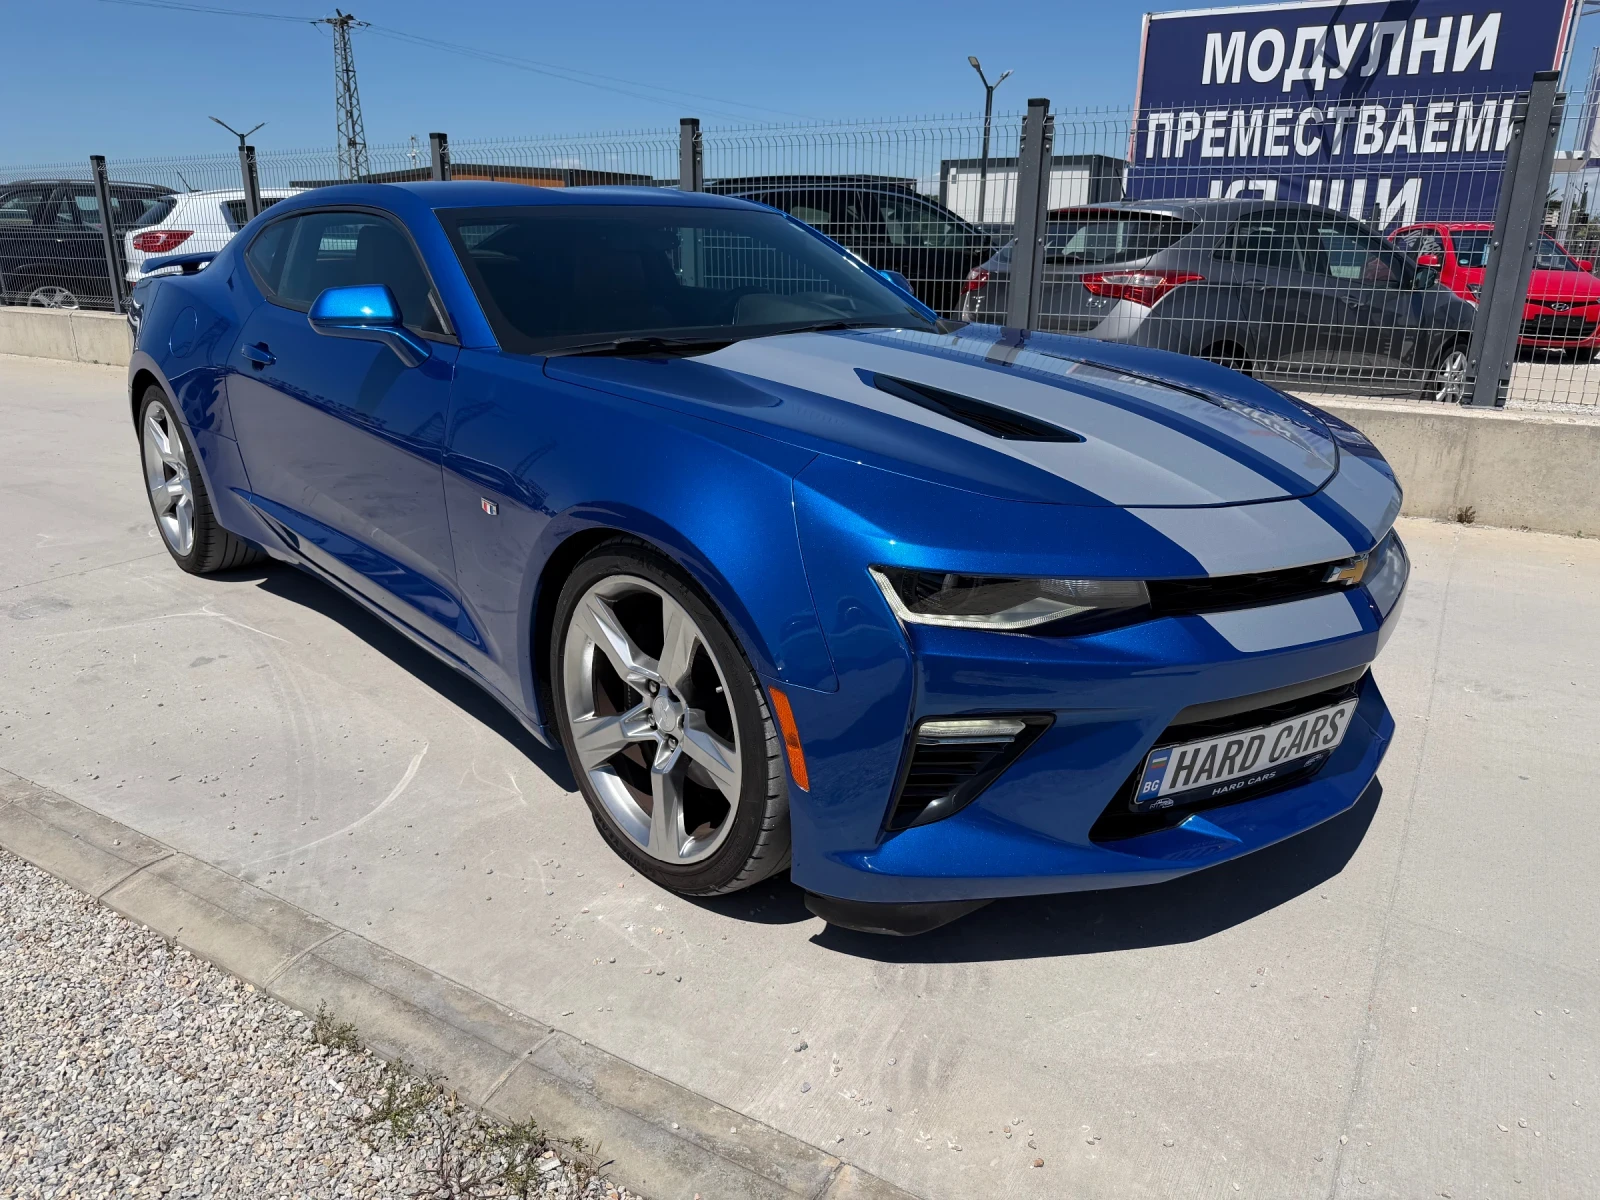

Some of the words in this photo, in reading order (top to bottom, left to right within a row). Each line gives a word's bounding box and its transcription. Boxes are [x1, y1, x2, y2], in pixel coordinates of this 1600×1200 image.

[1201, 12, 1502, 93] МОДУЛНИ
[1169, 734, 1266, 790] HARD
[1268, 708, 1346, 764] CARS
[1142, 779, 1161, 793] BG
[1212, 781, 1245, 796] HARD
[1247, 770, 1277, 785] CARS
